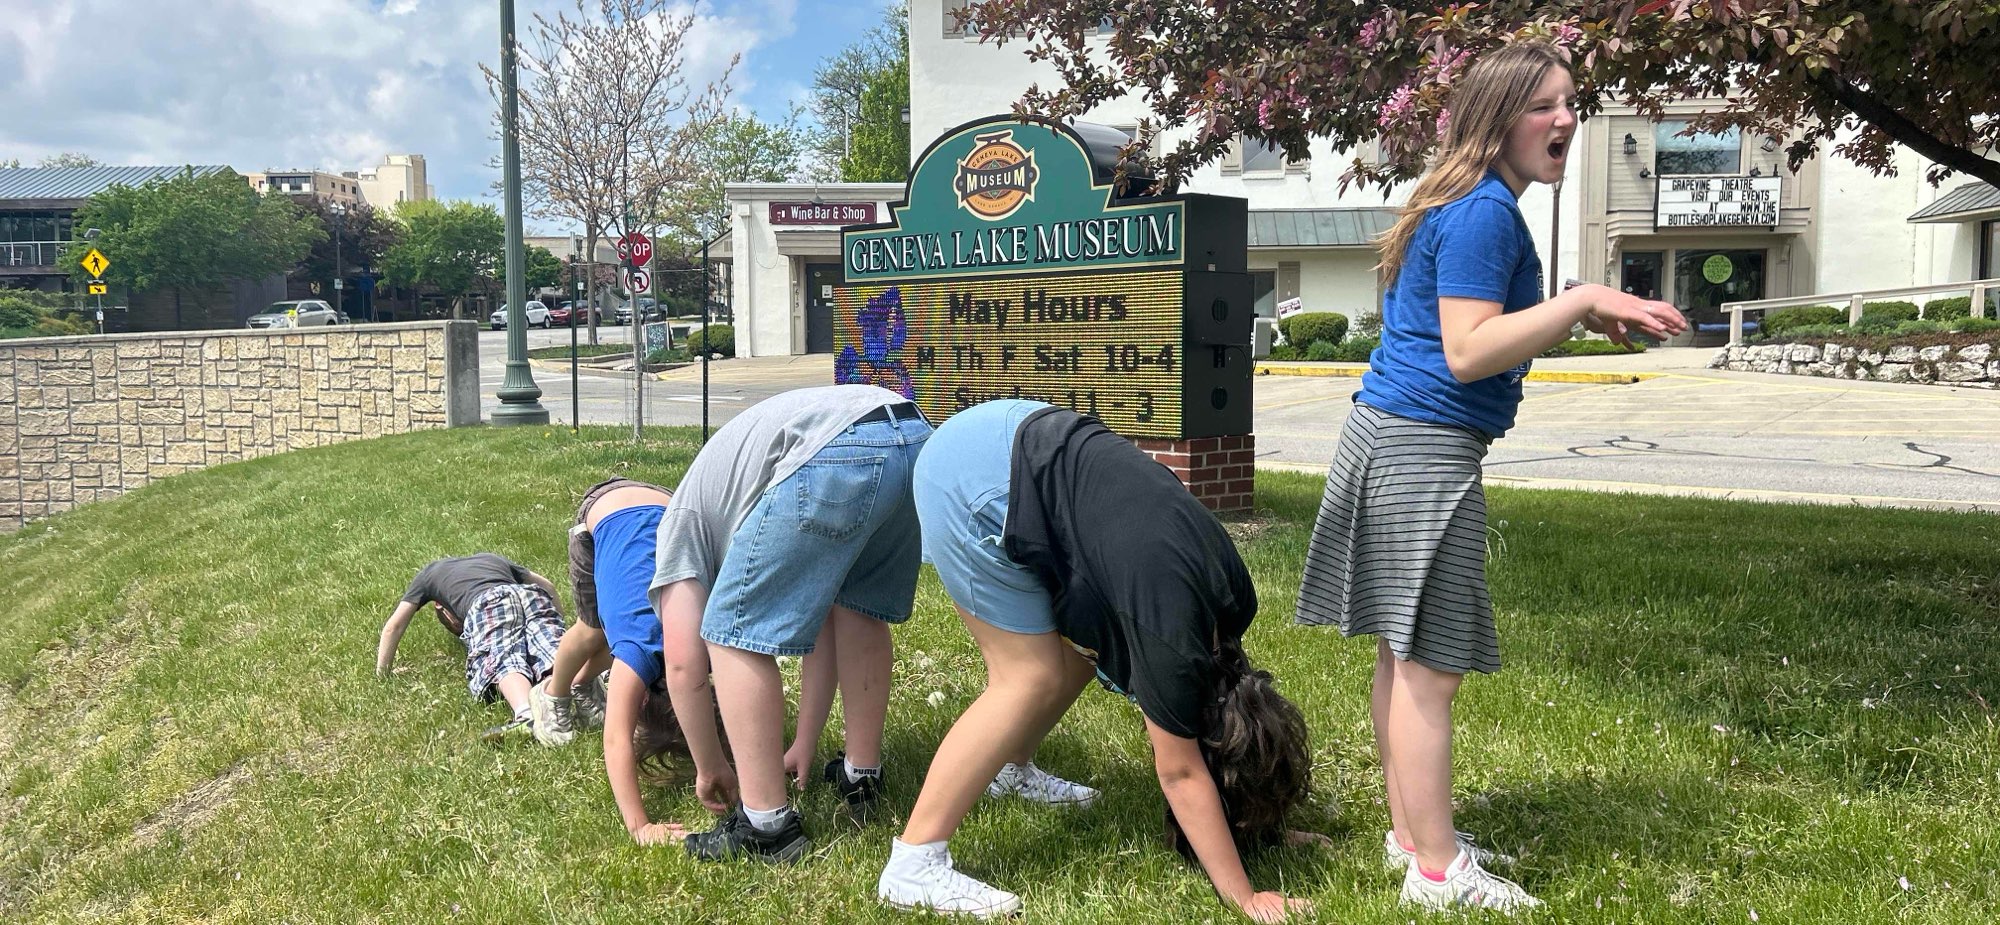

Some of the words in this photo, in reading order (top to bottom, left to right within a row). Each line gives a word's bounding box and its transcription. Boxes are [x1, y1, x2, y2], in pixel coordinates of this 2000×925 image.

[1001, 151, 1018, 163] LAKE
[966, 165, 1026, 194] MUSEUM
[1672, 179, 1711, 191] GRAPEVINE
[1721, 179, 1753, 190] THEATRE
[1690, 191, 1709, 202] VISIT
[1719, 190, 1733, 201] OUR
[1741, 190, 1770, 201] EVENTS
[790, 206, 813, 220] Wine
[814, 206, 830, 219] Bar
[832, 206, 839, 219] &
[842, 206, 866, 221] Shop
[1708, 202, 1718, 213] AT
[1740, 202, 1776, 213] WWW.THE
[1668, 213, 1777, 225] BOTTLESHOPLAKEGENEVA.COM
[850, 233, 946, 272] GENEVA
[951, 225, 1028, 266] LAKE
[1034, 213, 1175, 262] MUSEUM
[950, 292, 1011, 330] May
[1023, 289, 1128, 323] Hours
[916, 345, 935, 370] M
[952, 343, 984, 370] Th
[1002, 346, 1017, 370] F
[1034, 344, 1082, 373] Sat
[1105, 343, 1176, 372] 10-4
[1136, 391, 1154, 422] 3
